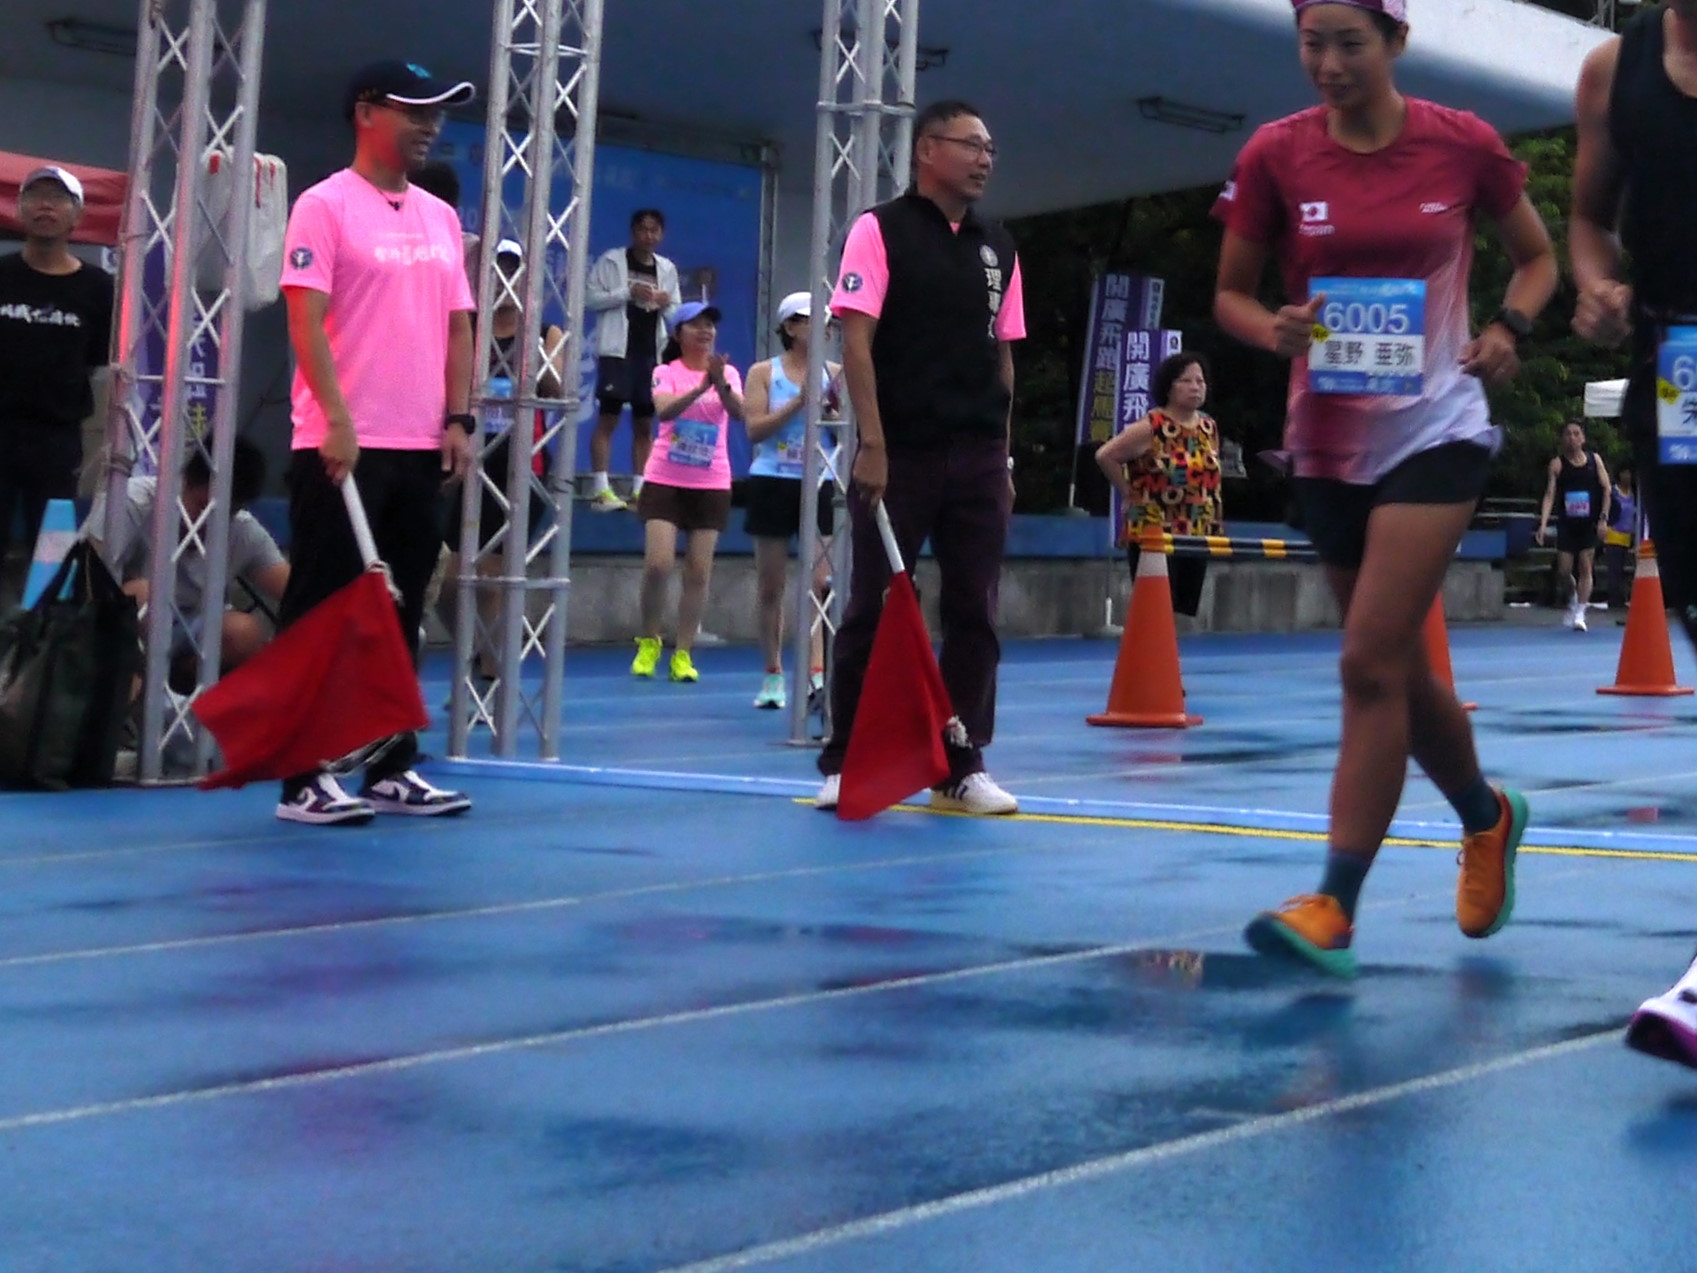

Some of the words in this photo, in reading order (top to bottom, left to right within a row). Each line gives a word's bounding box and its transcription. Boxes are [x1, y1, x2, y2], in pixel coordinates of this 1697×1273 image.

[1324, 302, 1409, 333] 6005
[1123, 331, 1150, 431] 開廣飛
